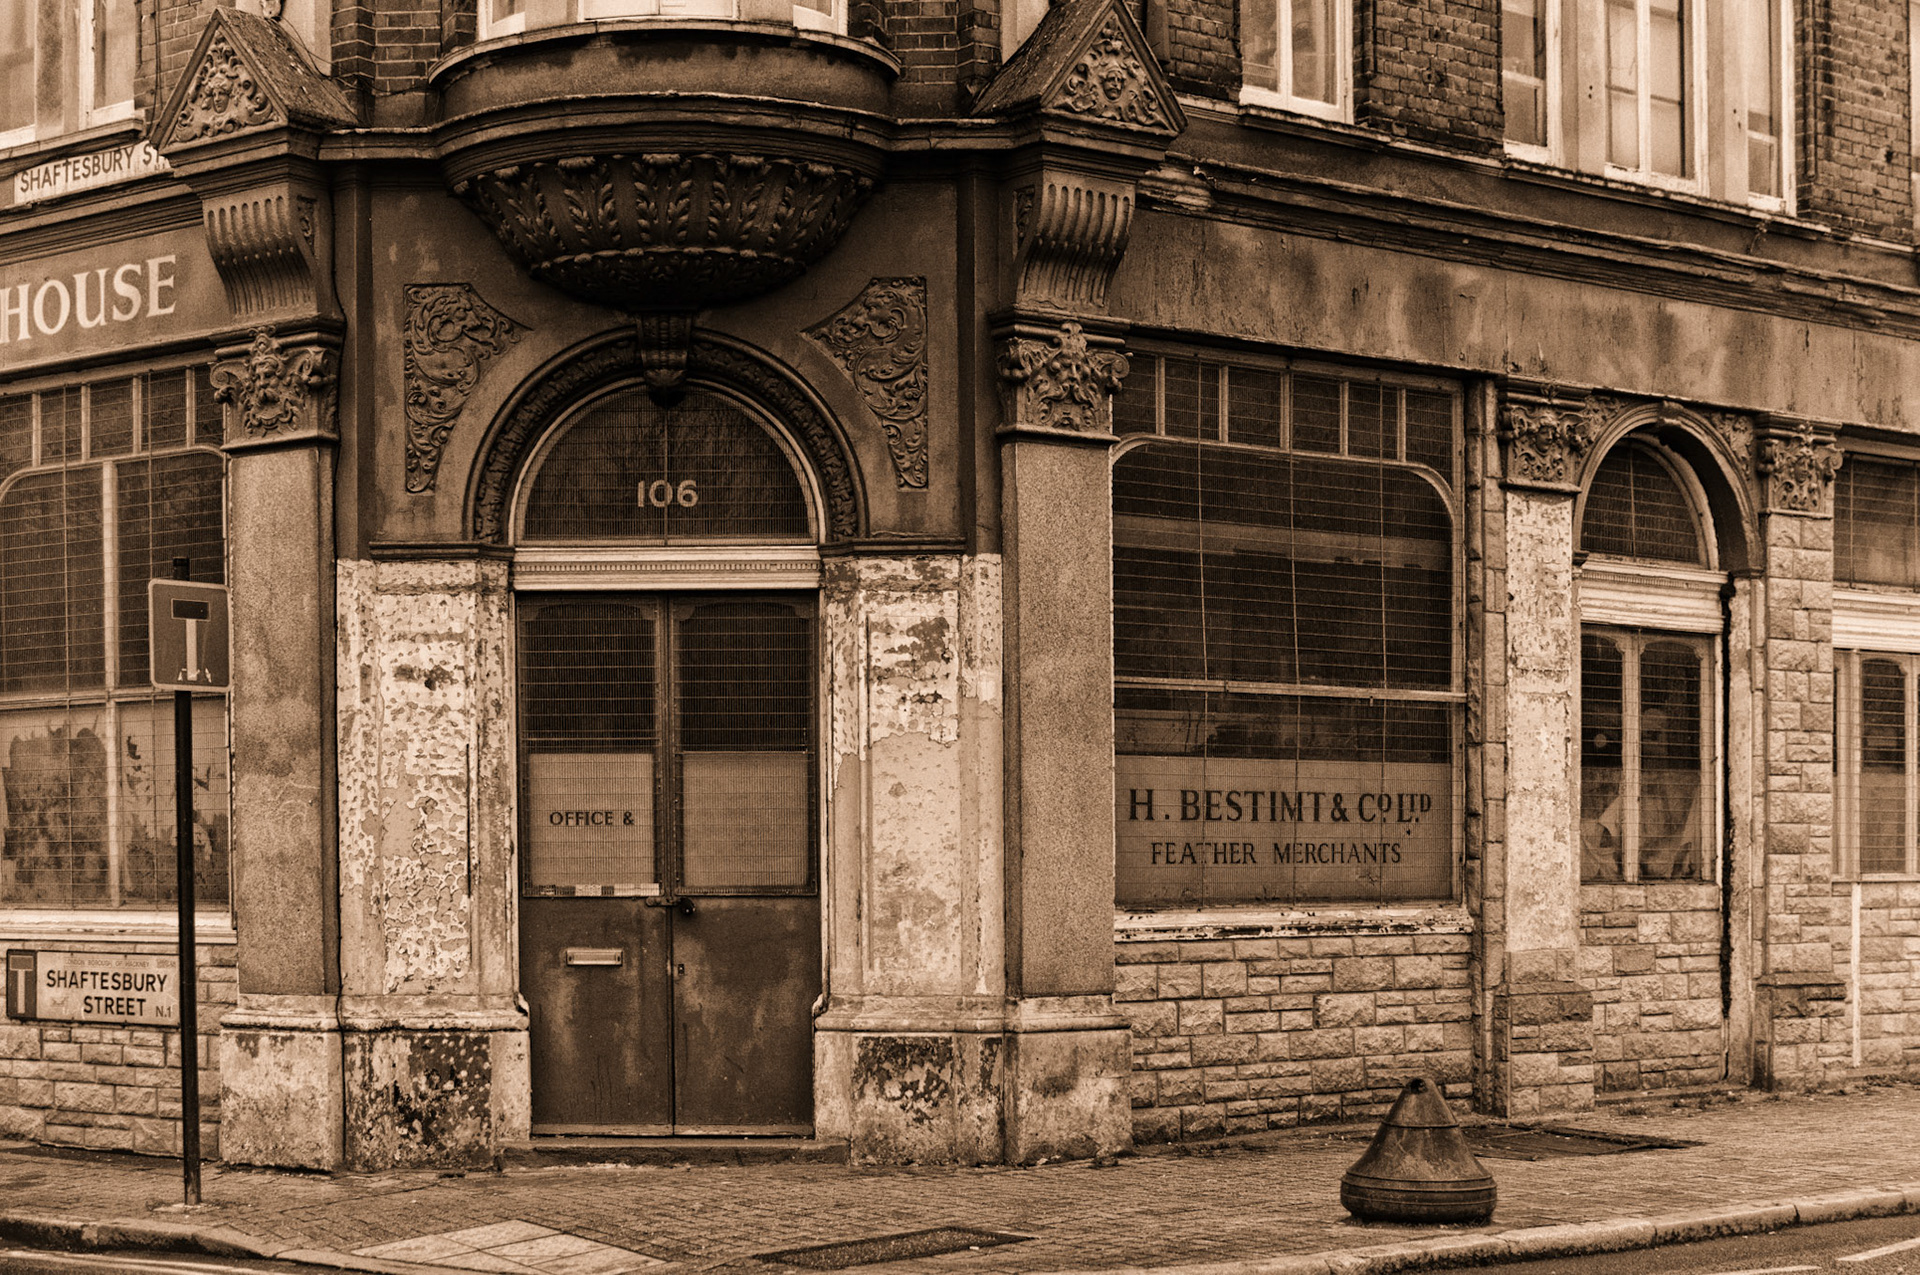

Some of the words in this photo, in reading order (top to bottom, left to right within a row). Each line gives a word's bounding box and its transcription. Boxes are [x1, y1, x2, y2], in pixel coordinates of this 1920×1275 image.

[20, 147, 135, 193] SHAFTESBURY
[143, 143, 168, 165] ST
[0, 255, 176, 345] HOUSE
[637, 480, 699, 508] 106
[1129, 789, 1170, 821] H.
[1180, 789, 1326, 822] BESTIMT
[1330, 792, 1350, 822] &
[549, 811, 614, 826] OFFICE
[622, 811, 635, 826] &
[1151, 842, 1257, 865] FEATHER
[1273, 842, 1402, 865] MERCHANTS
[46, 969, 168, 992] SHAFTESBURY
[83, 995, 147, 1017] STREET
[155, 1005, 172, 1018] N.1
